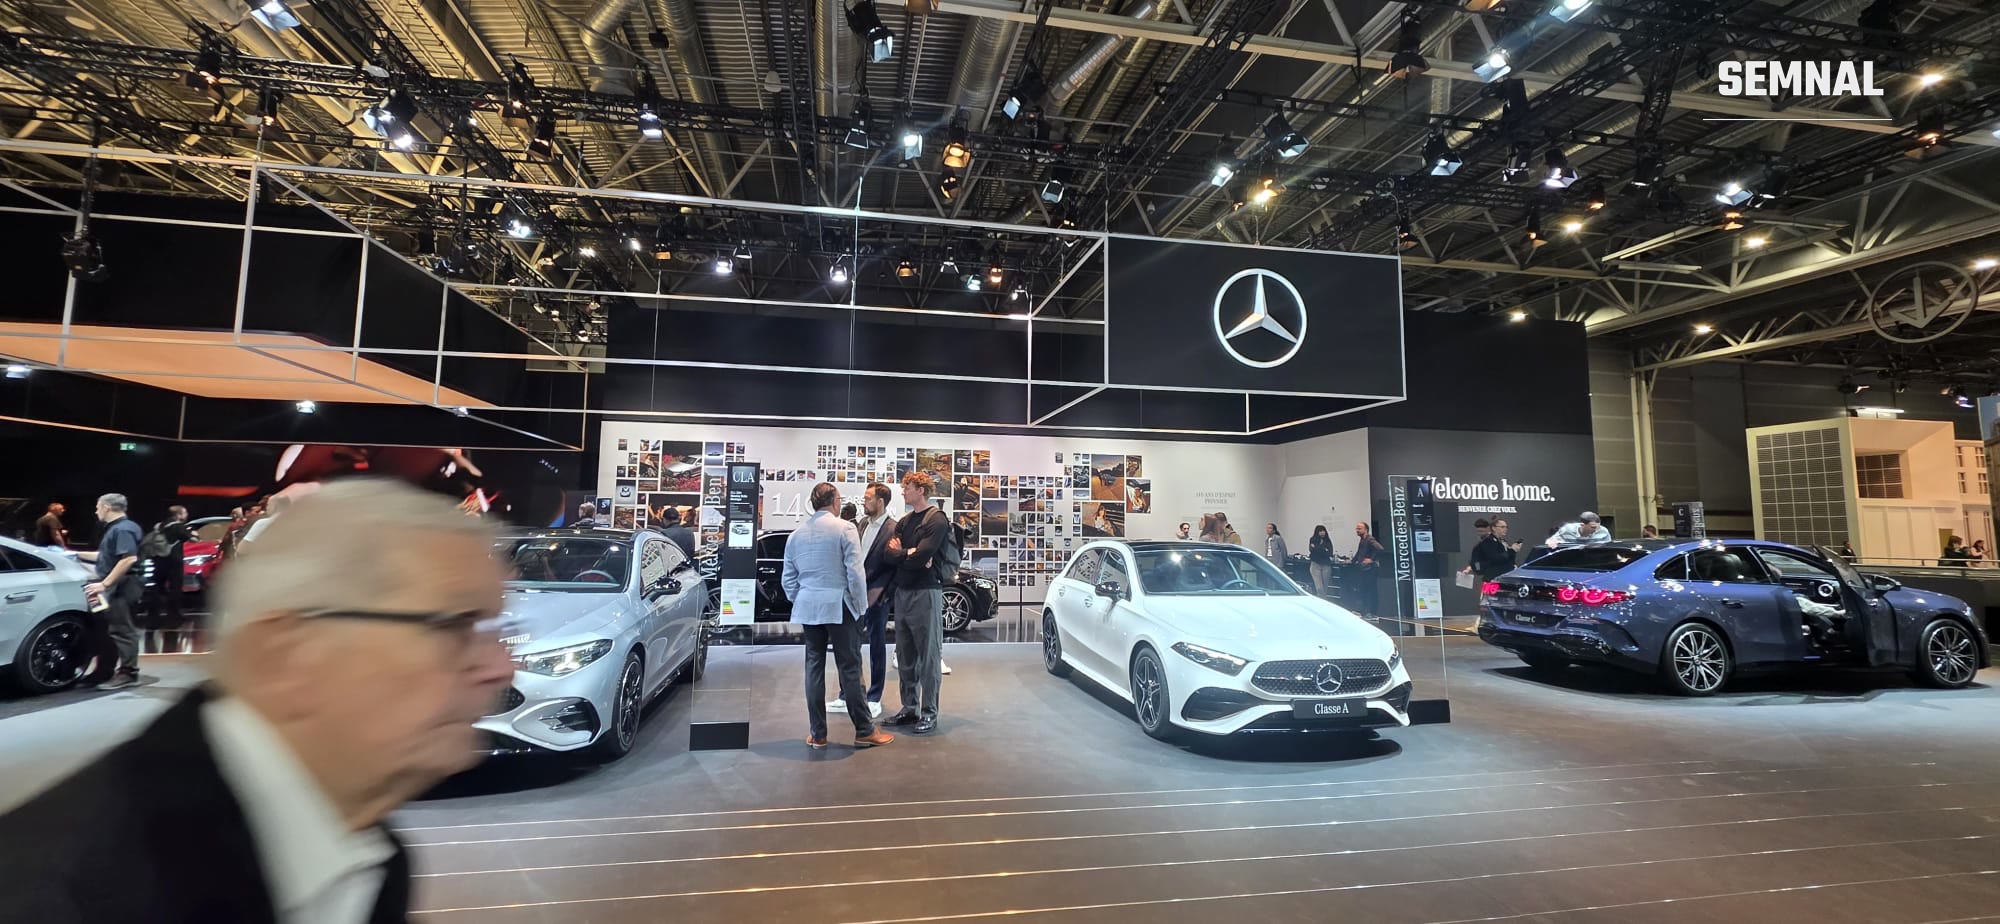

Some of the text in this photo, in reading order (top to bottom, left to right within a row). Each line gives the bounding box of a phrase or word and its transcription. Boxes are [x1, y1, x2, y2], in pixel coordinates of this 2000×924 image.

[732, 472, 755, 483] CLA
[1502, 478, 1555, 501] home.
[700, 473, 721, 581] MercedesBen
[1394, 486, 1411, 581] Mercedes-Benz
[1314, 702, 1349, 715] Classe A
